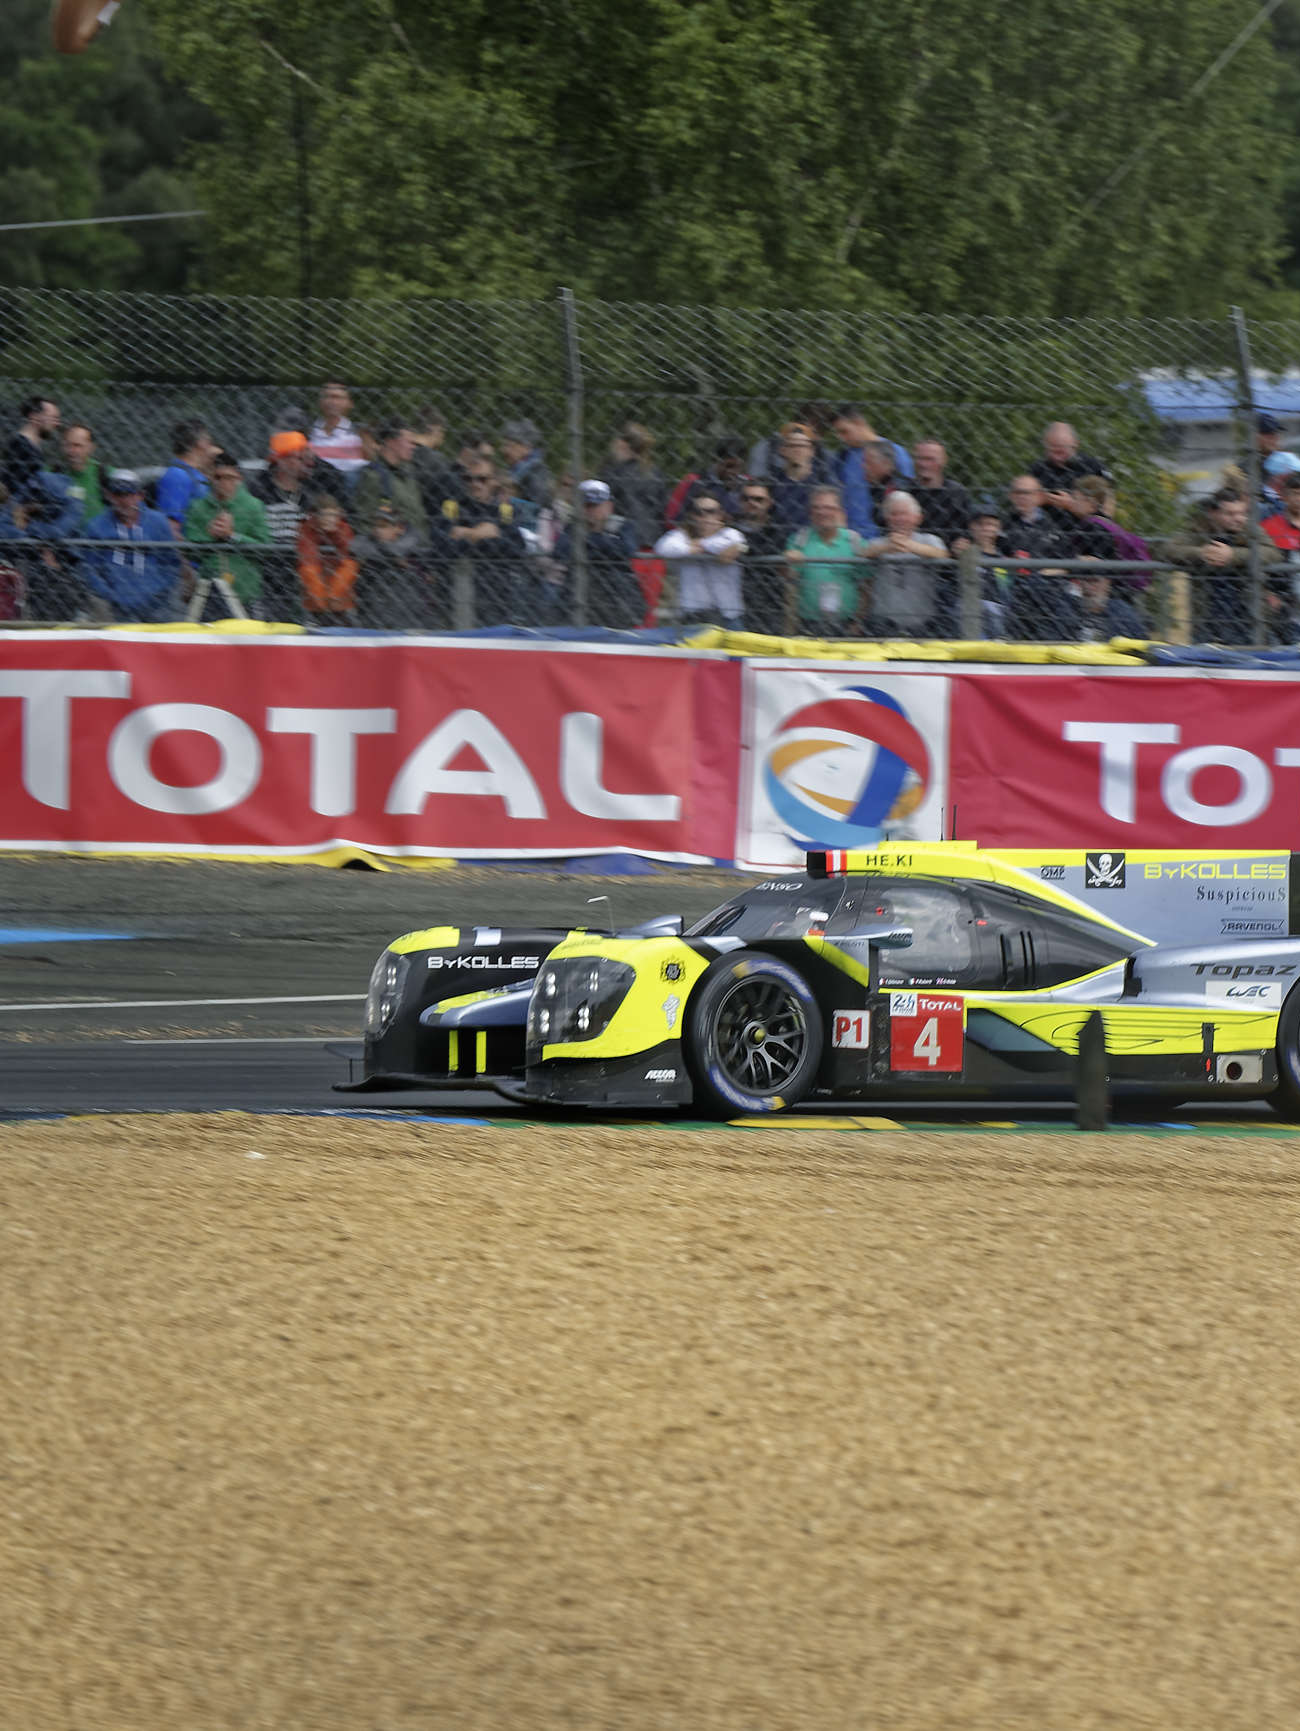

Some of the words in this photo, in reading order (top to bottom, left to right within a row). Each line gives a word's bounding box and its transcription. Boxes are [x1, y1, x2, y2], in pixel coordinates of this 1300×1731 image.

[0, 669, 682, 821] TOTAL
[1190, 962, 1298, 980] Topaz
[919, 998, 962, 1011] TOTAL
[835, 1016, 863, 1043] P1
[913, 1017, 941, 1067] 4
